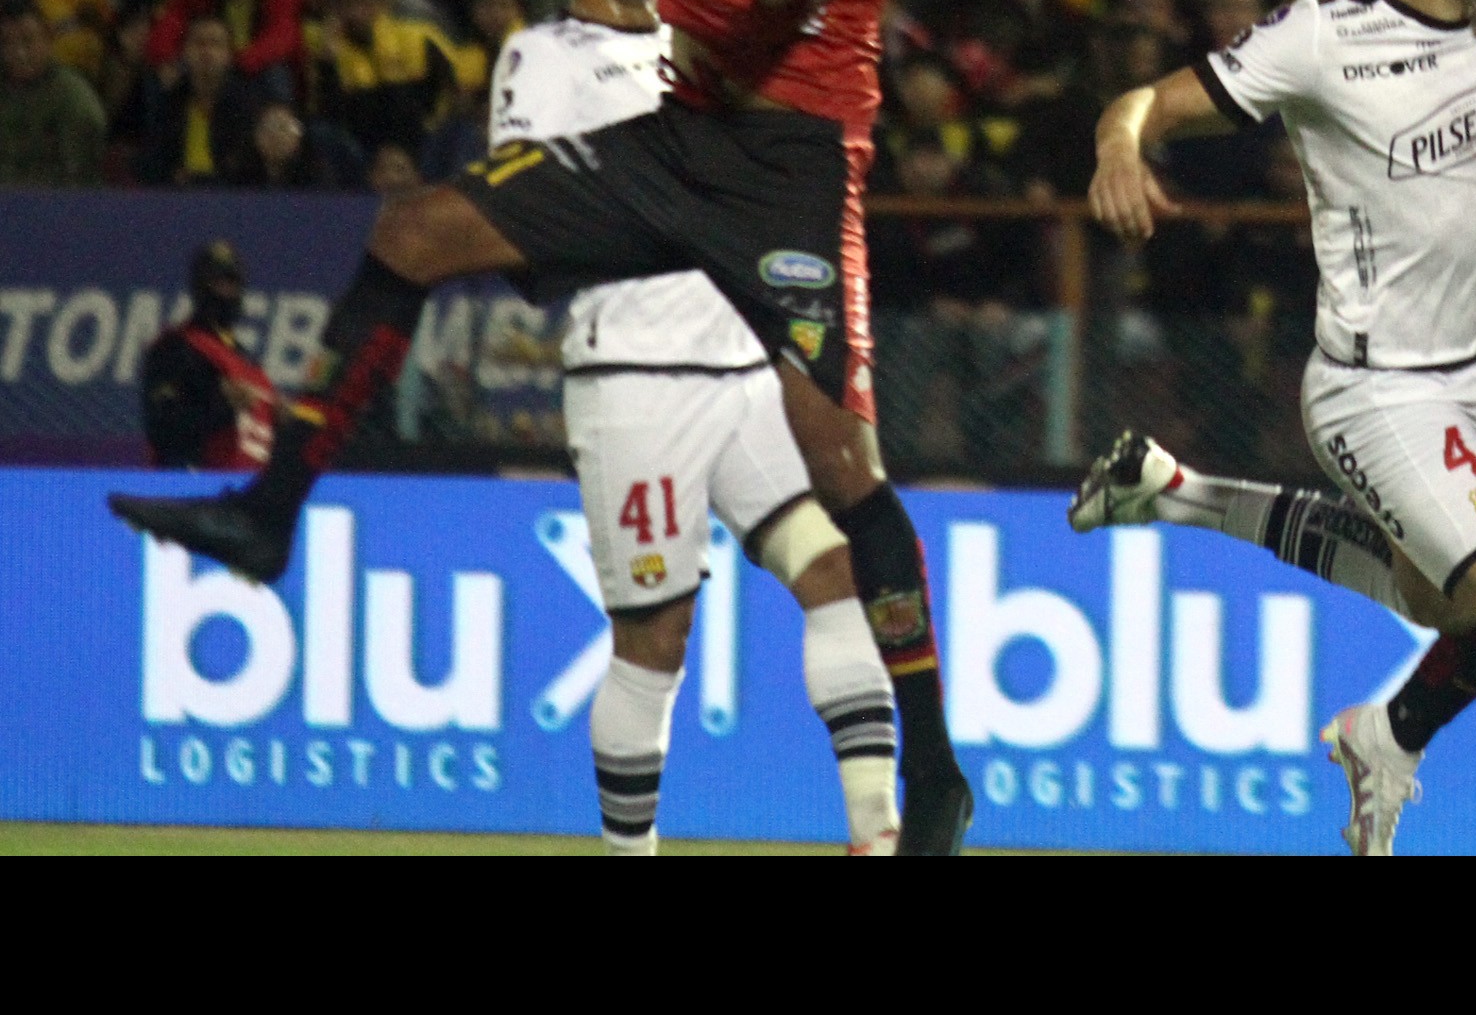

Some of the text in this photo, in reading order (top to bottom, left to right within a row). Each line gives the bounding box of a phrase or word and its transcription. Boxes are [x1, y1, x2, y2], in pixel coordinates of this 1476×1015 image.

[617, 476, 682, 545] 41
[142, 504, 503, 732] blu
[946, 520, 1314, 755] blu
[139, 735, 501, 791] LOGISTICS
[983, 758, 1314, 817] OGISTICS
